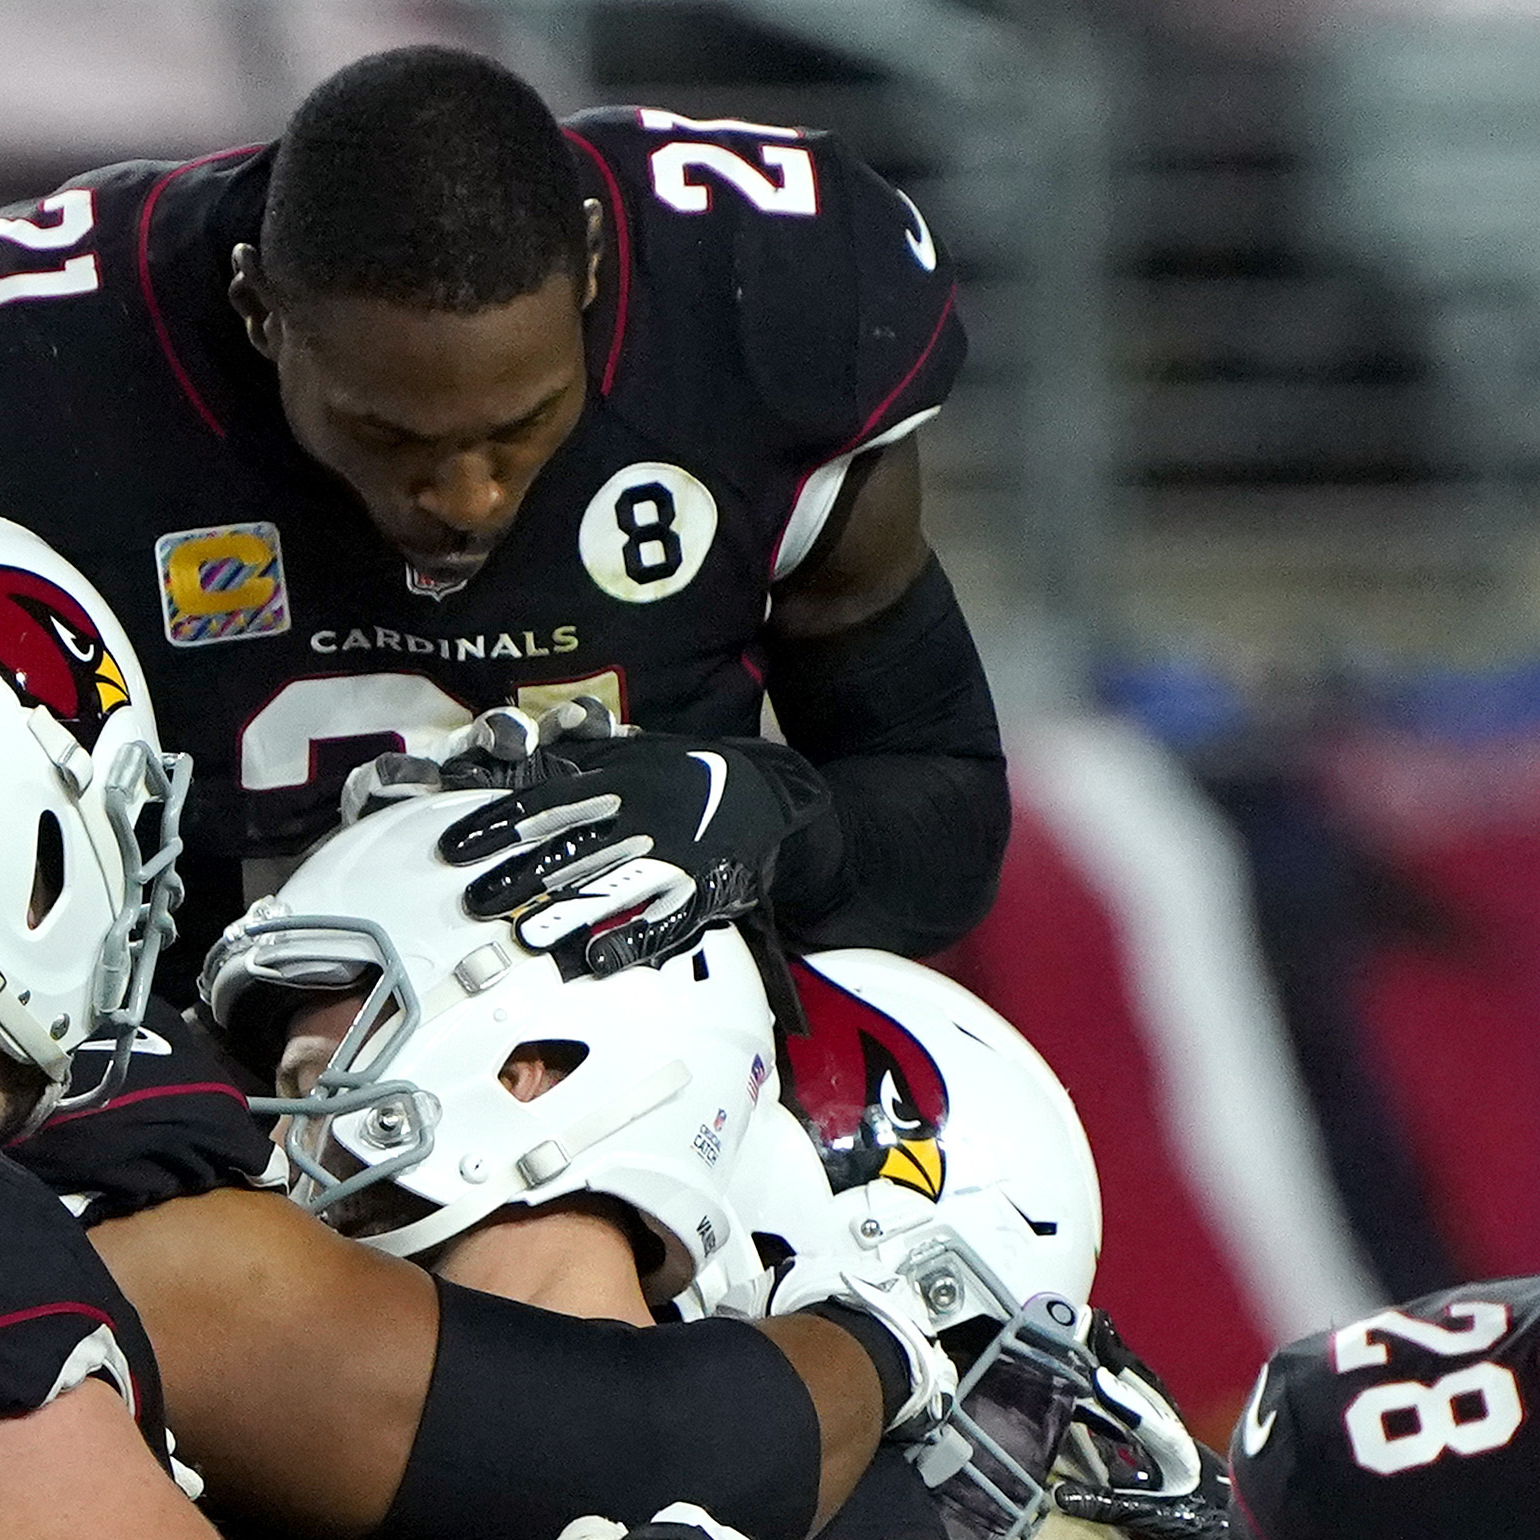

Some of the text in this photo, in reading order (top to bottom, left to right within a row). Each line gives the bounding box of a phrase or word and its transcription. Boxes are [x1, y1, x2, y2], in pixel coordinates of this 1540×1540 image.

[168, 533, 272, 616] C
[614, 480, 683, 585] 8
[311, 625, 579, 661] CARDINALS
[1331, 1299, 1525, 1477] 28
